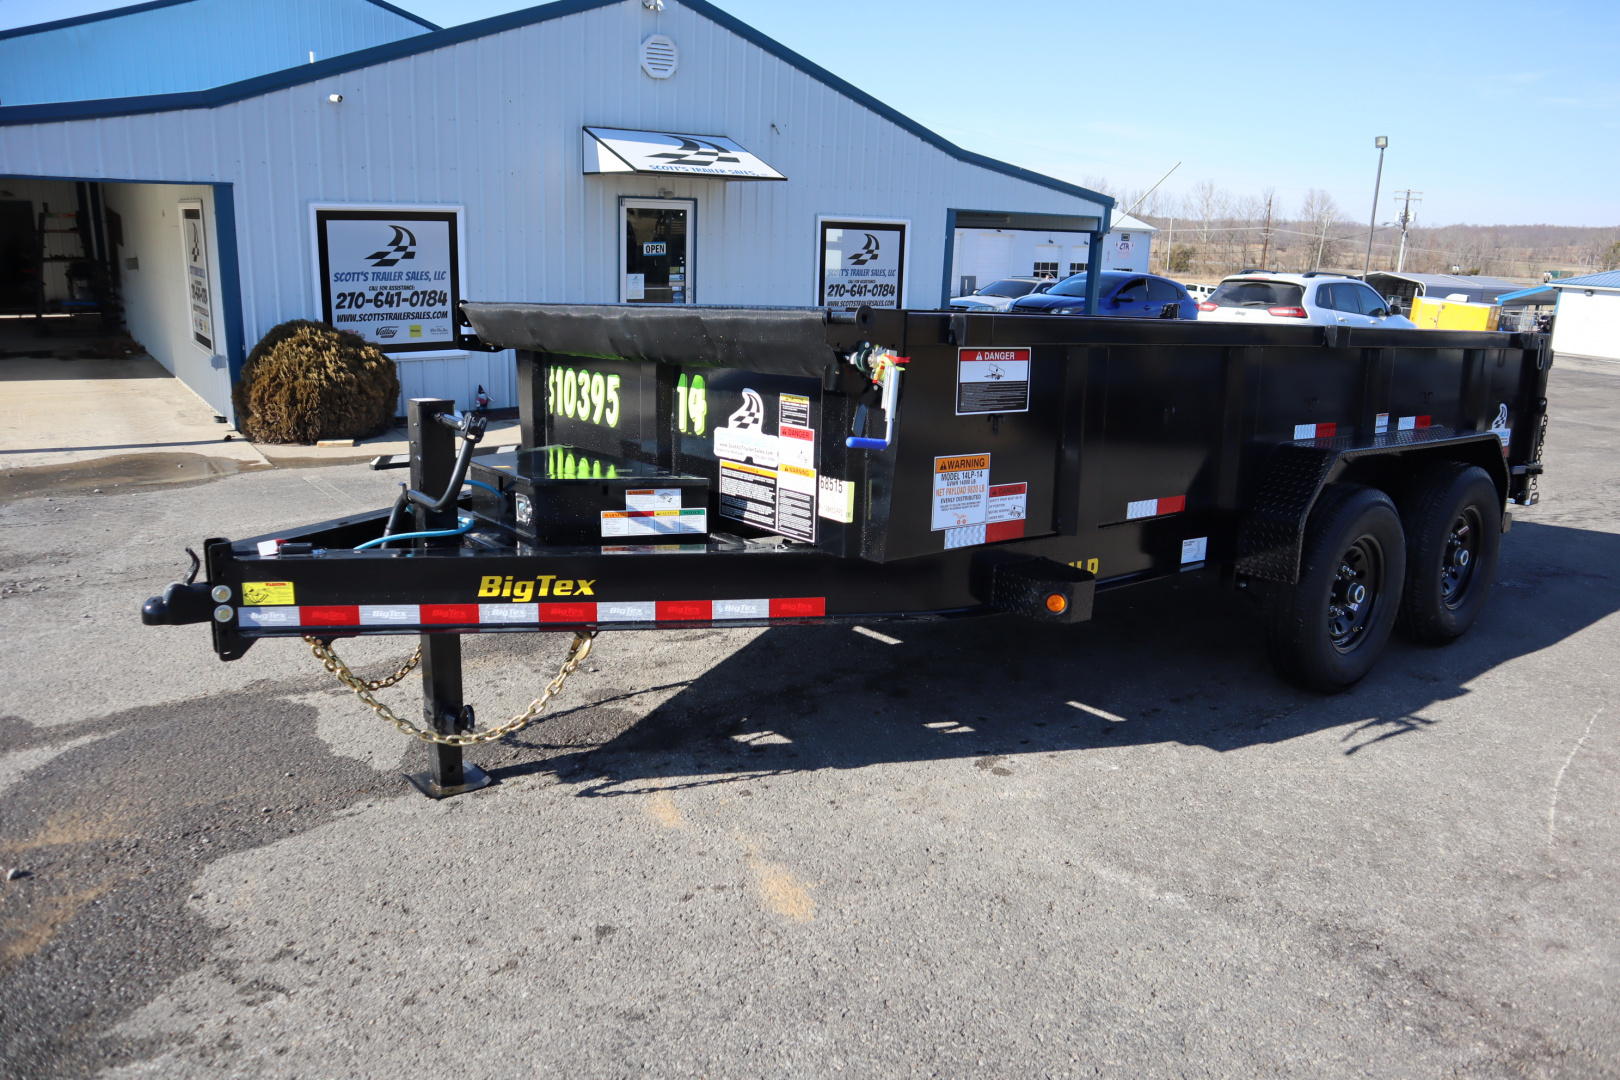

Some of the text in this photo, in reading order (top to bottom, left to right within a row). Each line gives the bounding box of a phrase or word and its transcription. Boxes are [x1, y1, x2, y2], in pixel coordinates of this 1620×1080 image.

[646, 244, 665, 253] OPEN
[334, 271, 446, 282] SCOTT'S TRAILER SALES, LLC
[827, 268, 849, 277] SCOTT'S
[871, 269, 886, 277] SALES,
[827, 284, 895, 297] 270-641-0784
[336, 290, 447, 309] 270-641-0784
[337, 311, 448, 322] WWW.SCOTTSTRAILERSALES.COM
[376, 326, 399, 336] Valley
[985, 352, 1015, 360] DANGER
[549, 365, 620, 428] $10395
[677, 373, 707, 435] 14
[788, 428, 809, 439] DANGER
[947, 458, 985, 469] WARNING
[789, 466, 809, 477] WARNING
[941, 471, 983, 481] MODEL 14LP-14
[936, 488, 945, 497] NET
[946, 486, 966, 496] PAYLOAD
[999, 486, 1022, 494] DANGER
[478, 575, 596, 602] BigTex
